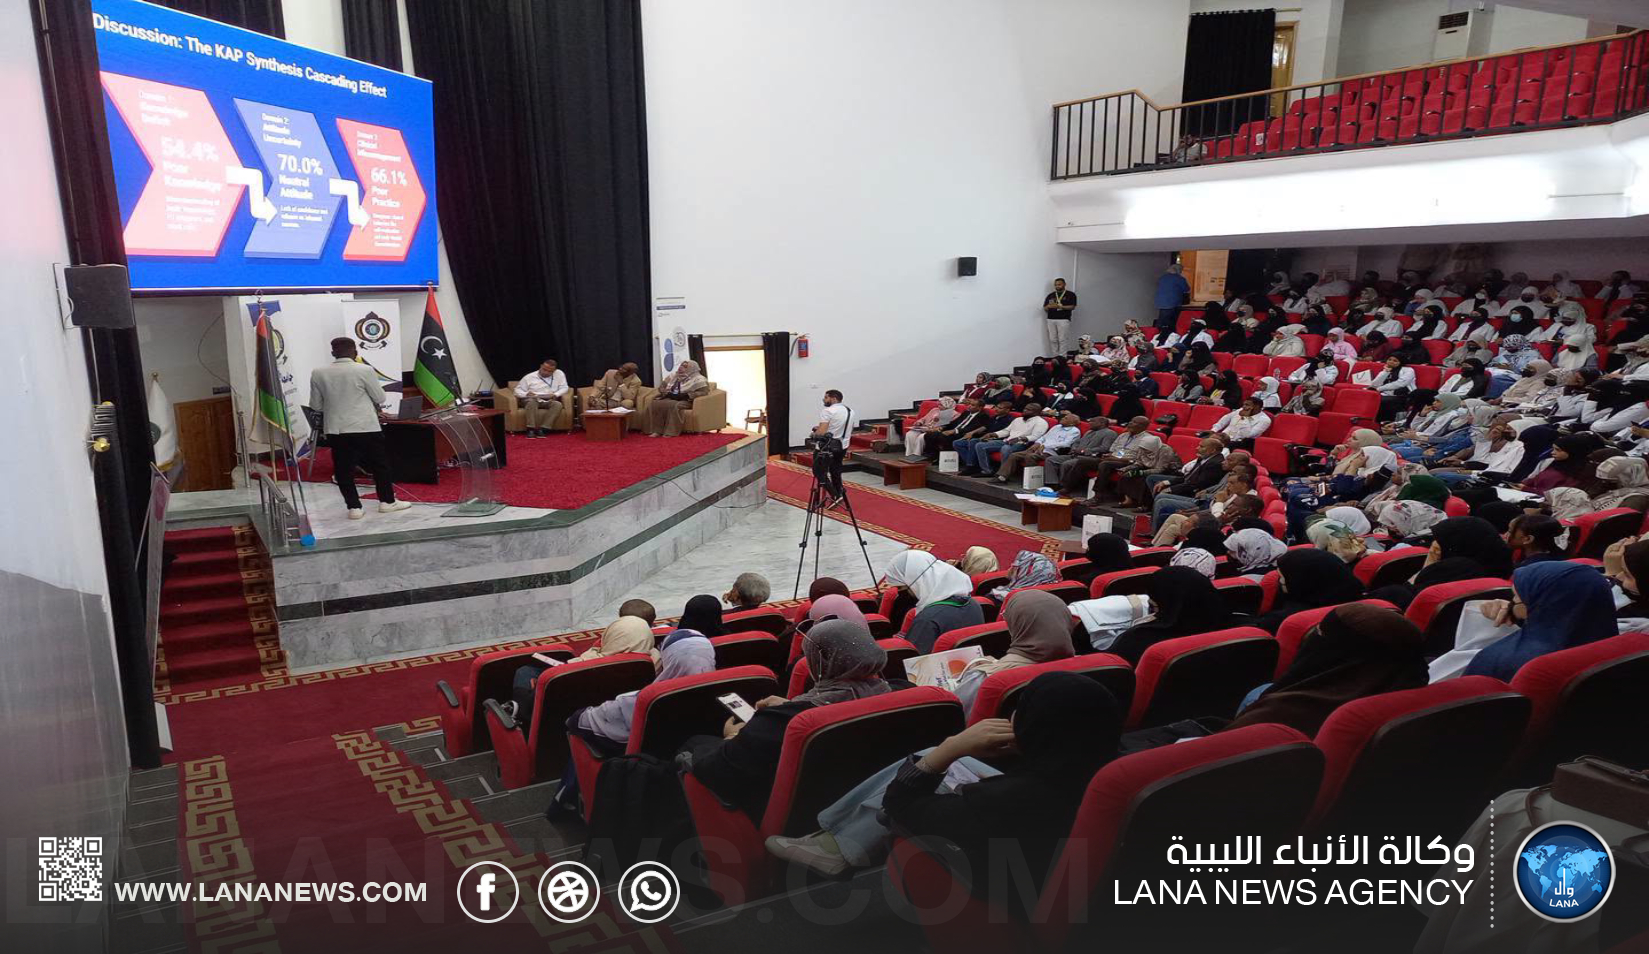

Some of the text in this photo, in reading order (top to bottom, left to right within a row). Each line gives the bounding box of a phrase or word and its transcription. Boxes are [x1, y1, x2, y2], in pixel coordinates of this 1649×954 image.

[92, 12, 387, 98] Discussion: The KAP Synthesis Cascading Effect
[277, 153, 323, 176] 70.0%
[371, 167, 407, 187] 66.1%
